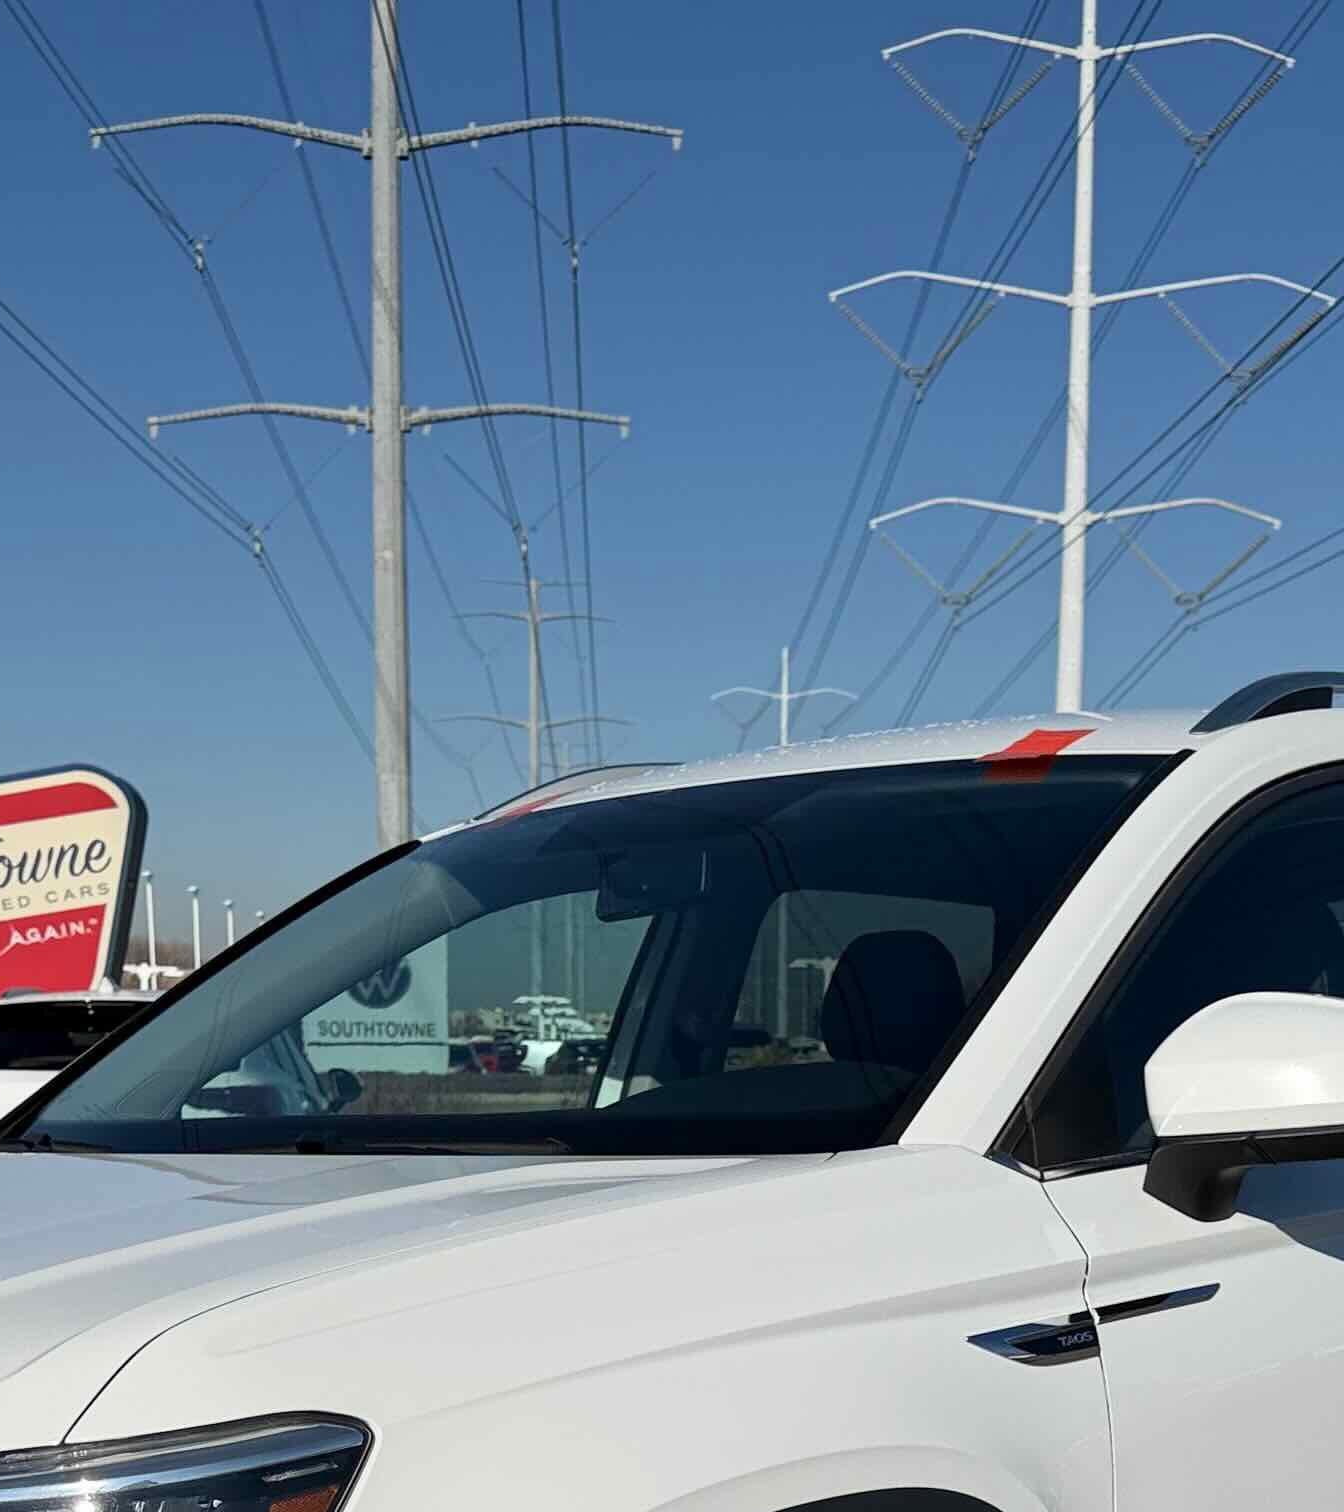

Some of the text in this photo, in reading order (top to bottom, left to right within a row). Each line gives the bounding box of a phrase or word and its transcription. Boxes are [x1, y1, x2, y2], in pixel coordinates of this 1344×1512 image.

[45, 881, 112, 904] CARS
[317, 1019, 438, 1039] SOUTHTOWNE
[1058, 1330, 1094, 1348] TAOS
